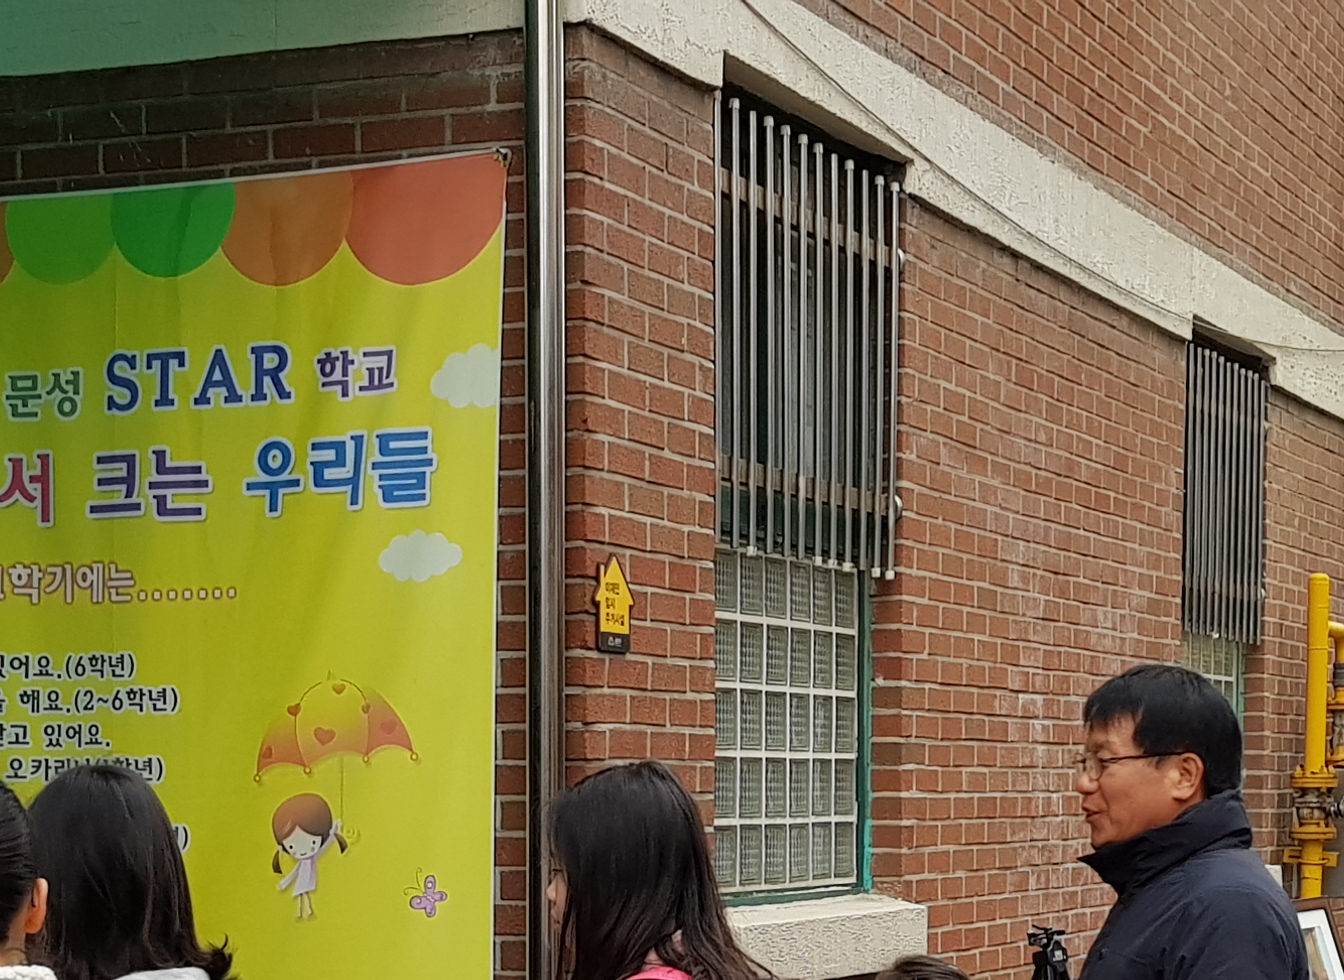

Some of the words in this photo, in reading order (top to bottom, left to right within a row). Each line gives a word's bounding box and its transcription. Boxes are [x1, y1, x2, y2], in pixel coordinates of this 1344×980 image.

[4, 369, 82, 419] 문성
[105, 343, 293, 412] STAR
[316, 348, 395, 399] 학교
[88, 449, 211, 519] 크는
[245, 430, 435, 514] 우리들
[18, 686, 179, 714] 해요.(2~6학년)
[43, 723, 112, 749] 있어요.
